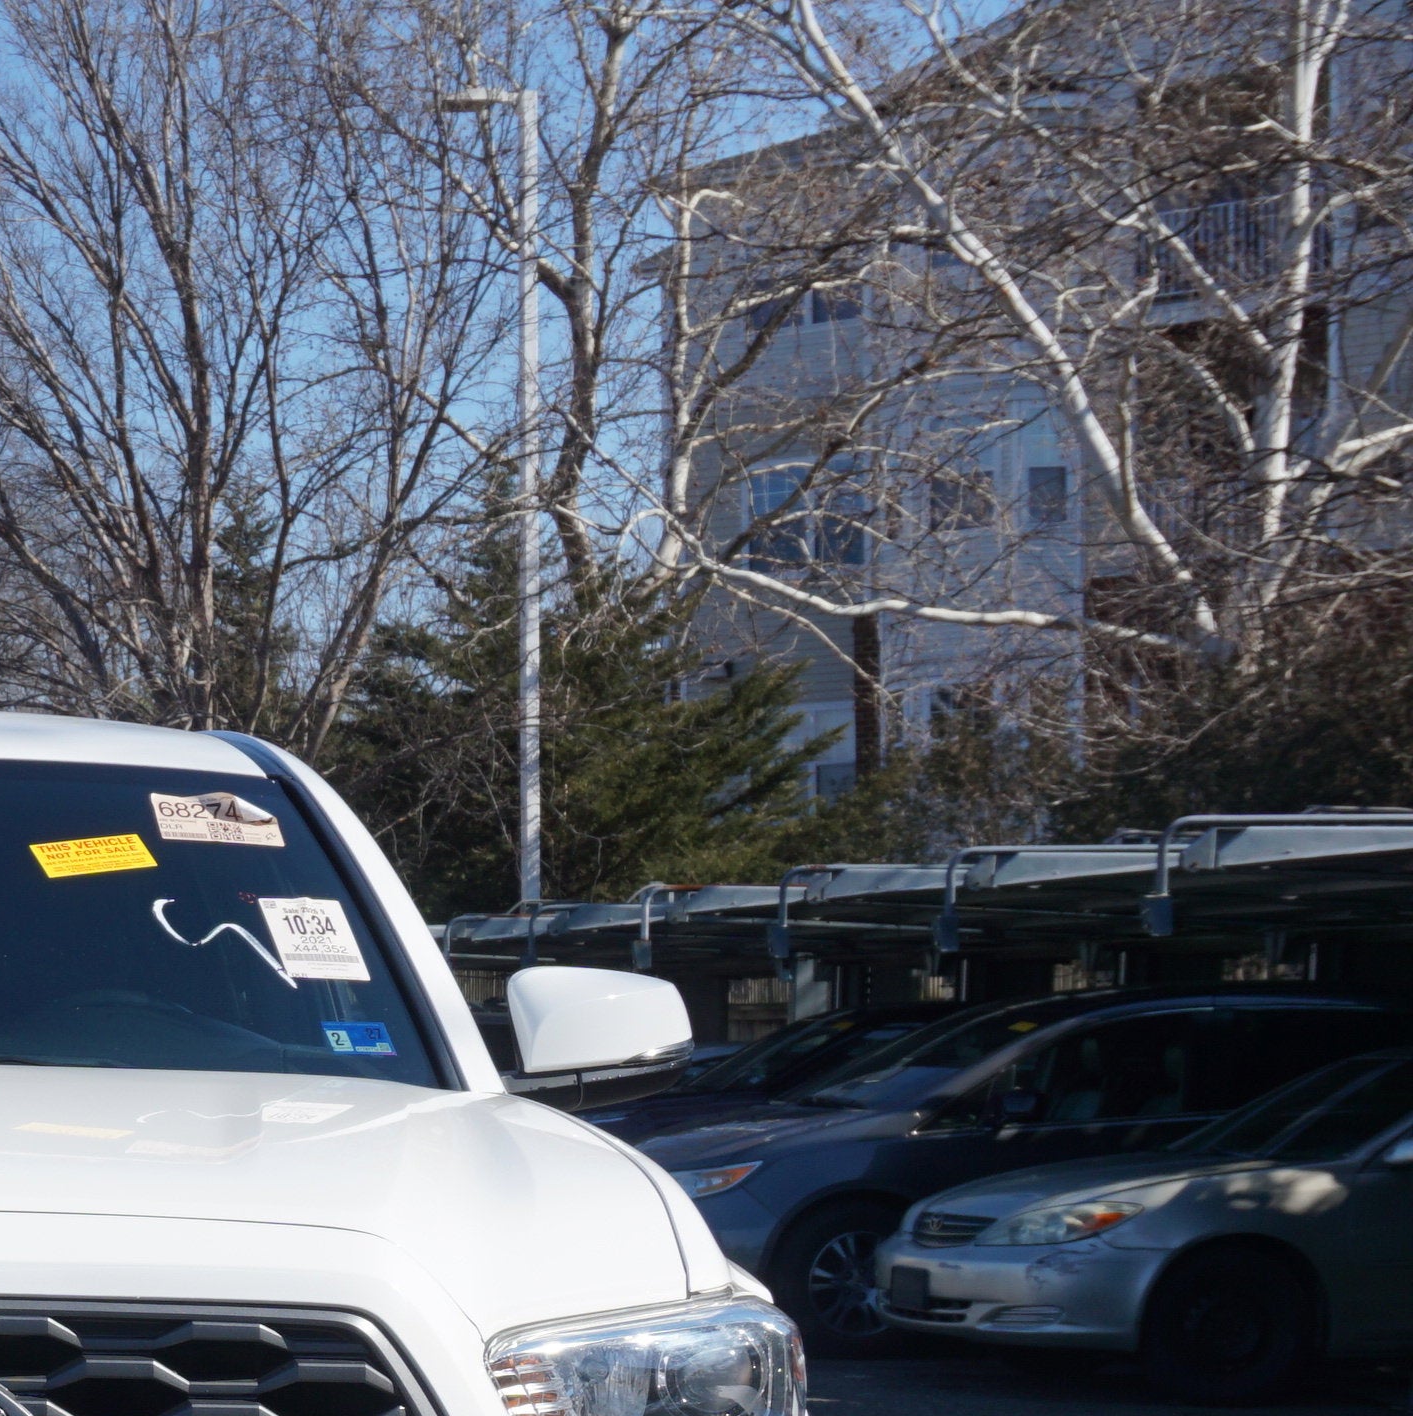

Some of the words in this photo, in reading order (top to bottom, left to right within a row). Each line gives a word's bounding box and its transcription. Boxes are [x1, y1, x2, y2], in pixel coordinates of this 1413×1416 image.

[158, 800, 243, 821] 68274
[37, 843, 71, 853] THIS
[74, 836, 136, 849] VEHICLE
[46, 851, 71, 860] NOT
[75, 849, 101, 857] FOR
[106, 845, 137, 853] SALE
[282, 915, 337, 935] 10:34
[300, 936, 332, 944] 2021
[331, 1032, 345, 1046] 2
